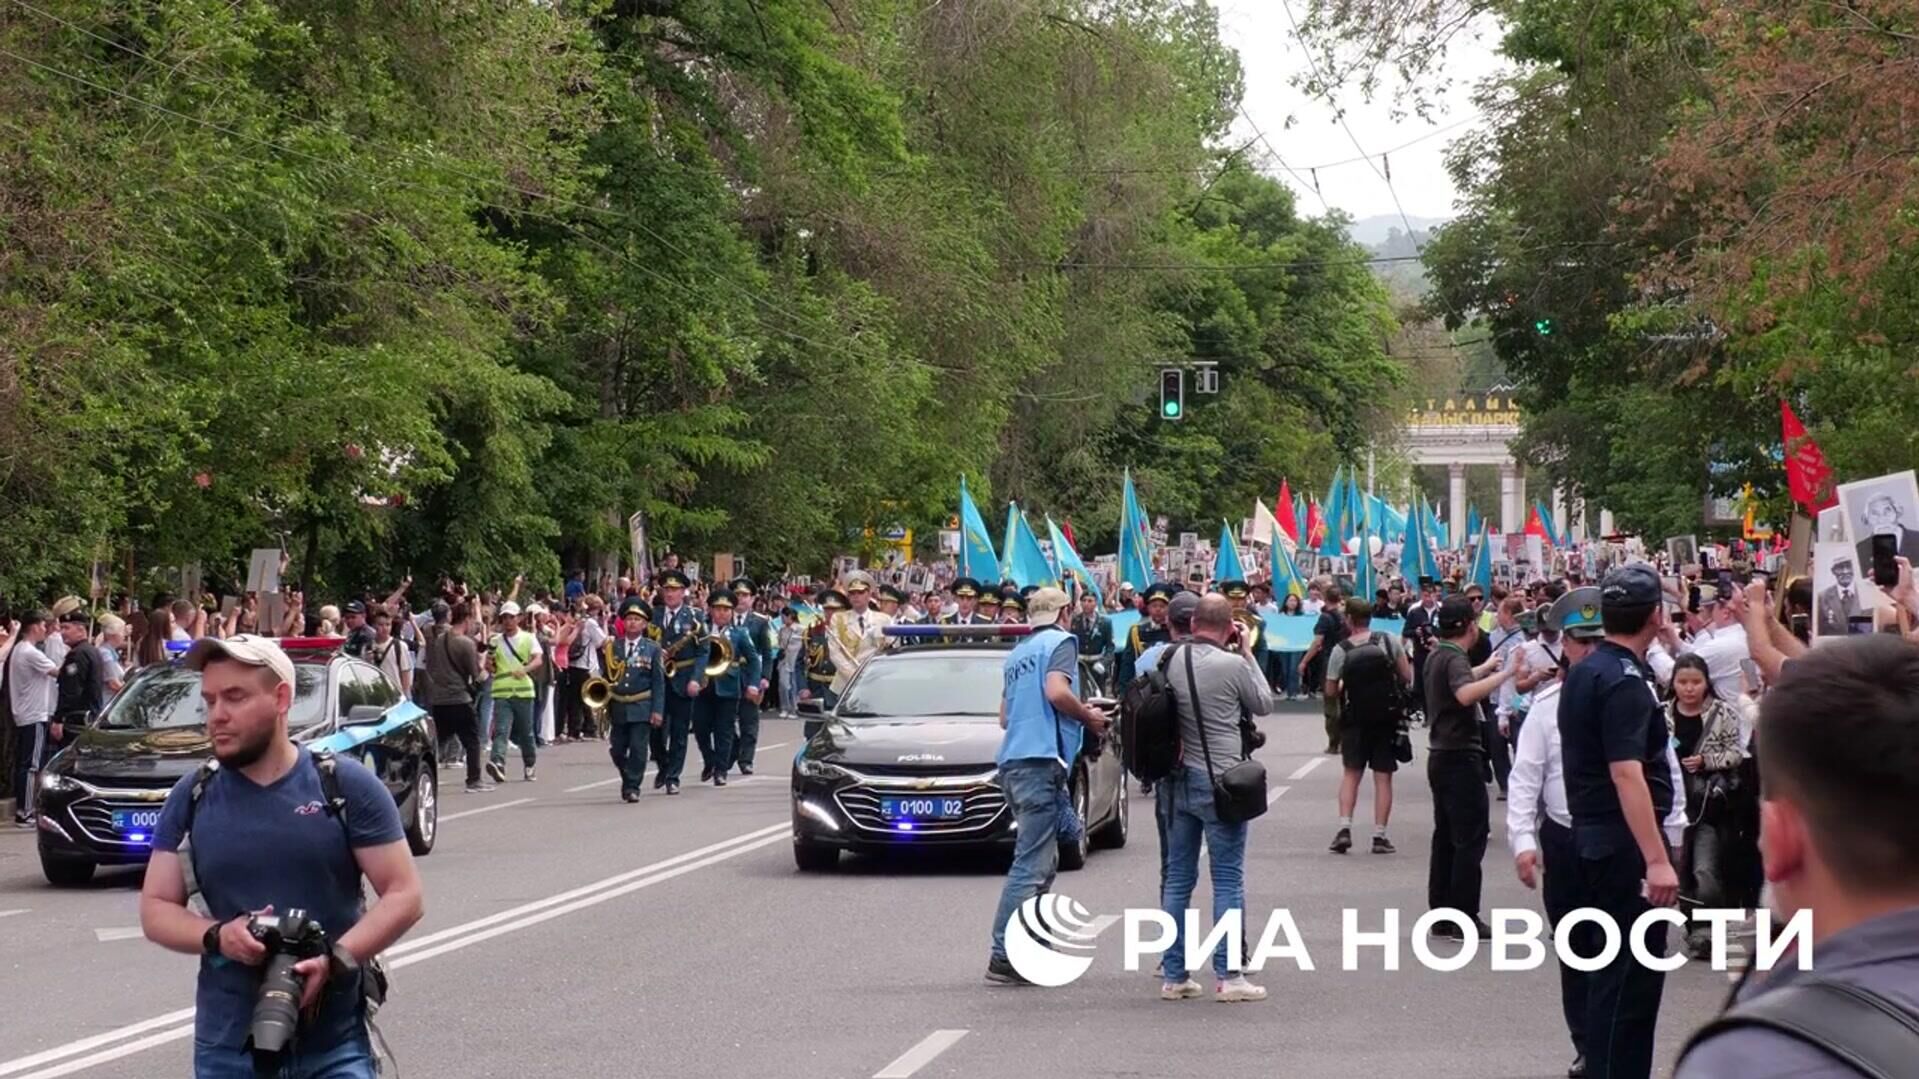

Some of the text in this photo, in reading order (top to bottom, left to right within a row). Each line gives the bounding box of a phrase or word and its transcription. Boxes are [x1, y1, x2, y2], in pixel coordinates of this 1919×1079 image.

[900, 800, 962, 815] 0100 02
[131, 812, 161, 826] 000
